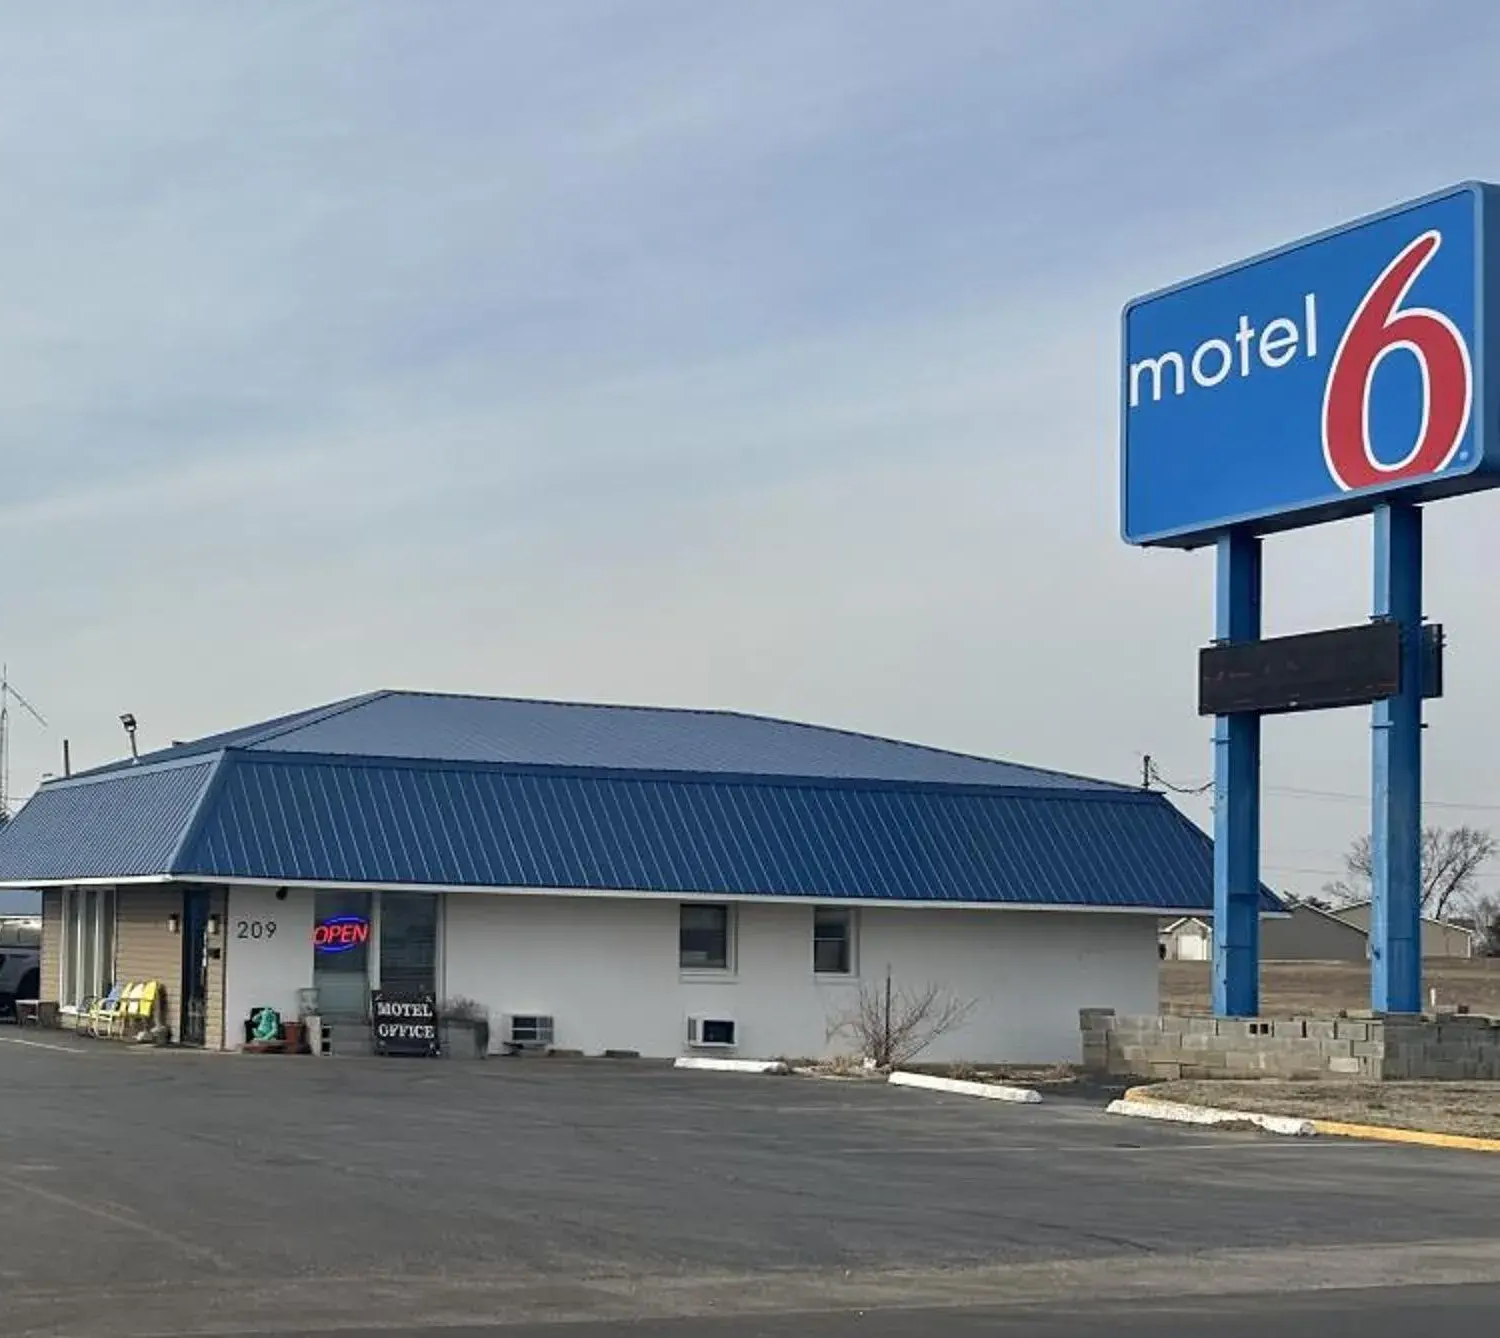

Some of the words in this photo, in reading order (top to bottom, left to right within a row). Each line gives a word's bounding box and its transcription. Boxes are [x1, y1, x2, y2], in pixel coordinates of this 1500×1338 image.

[1129, 292, 1318, 407] motel
[1320, 229, 1474, 493] 6
[237, 920, 278, 940] 209
[312, 923, 370, 945] OPEN
[377, 1001, 434, 1017] MOTEL
[378, 1023, 435, 1039] OFFICE
